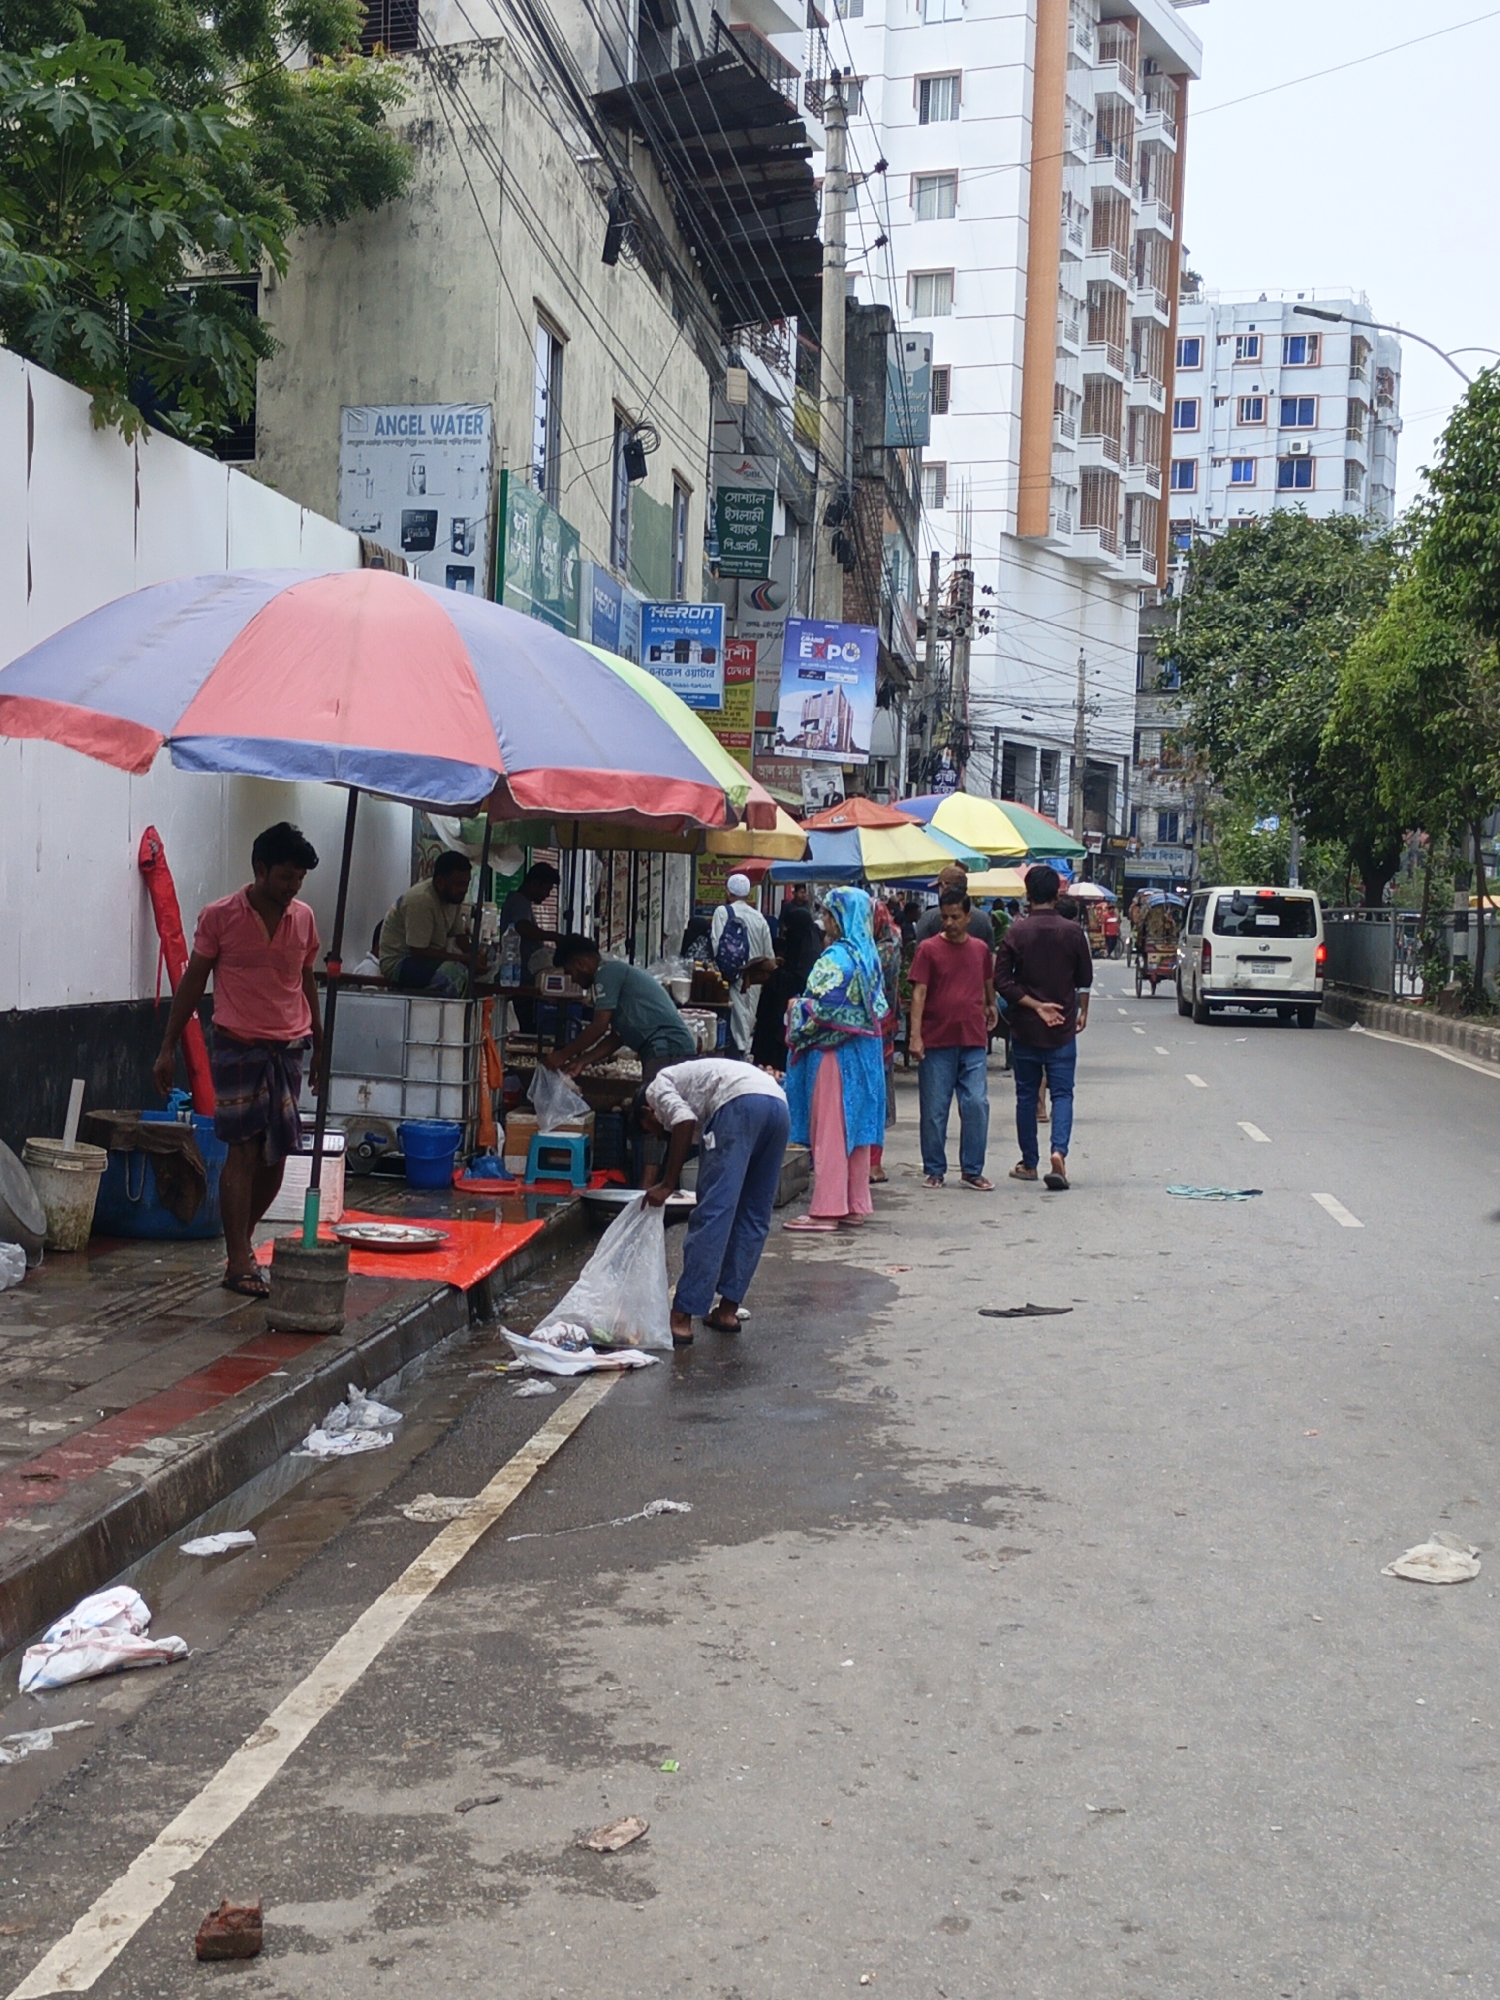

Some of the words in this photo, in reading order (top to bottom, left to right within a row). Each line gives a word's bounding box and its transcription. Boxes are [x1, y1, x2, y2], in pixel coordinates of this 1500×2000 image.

[375, 415, 426, 436] ANGEL
[430, 414, 483, 435] WATER
[724, 492, 766, 505] সোশ্যাল
[724, 506, 764, 521] ইসলামী
[729, 523, 757, 536] ব্যাংক
[648, 606, 714, 620] HERON
[800, 638, 860, 662] EXPO
[685, 667, 715, 679] ওয়াটার
[757, 765, 775, 779] আল
